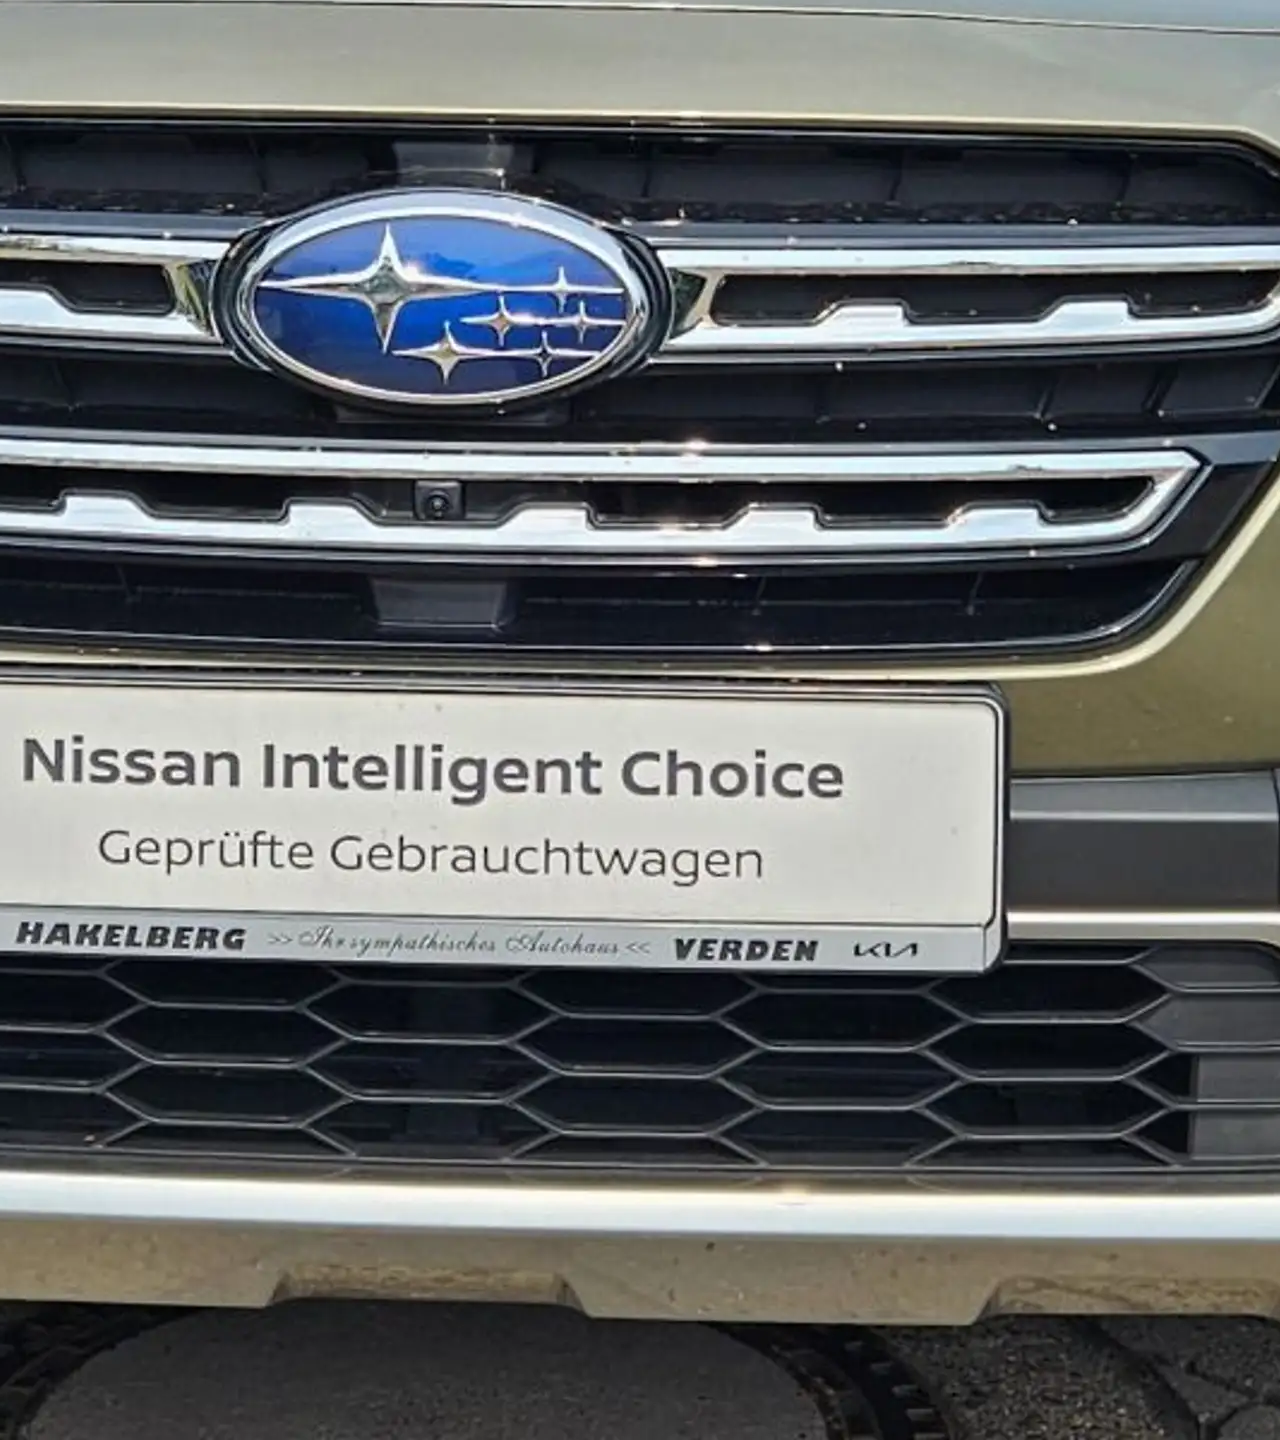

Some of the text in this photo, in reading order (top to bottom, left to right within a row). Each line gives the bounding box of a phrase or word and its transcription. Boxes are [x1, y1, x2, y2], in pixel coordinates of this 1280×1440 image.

[23, 735, 844, 806] Nissan Intelligent Choice
[98, 829, 763, 887] Geprüfte Gebrauchtwagen
[14, 920, 247, 951] HAKELBERG
[504, 930, 619, 955] Autohaus
[673, 937, 819, 962] VERDEN
[853, 942, 918, 958] KIA
